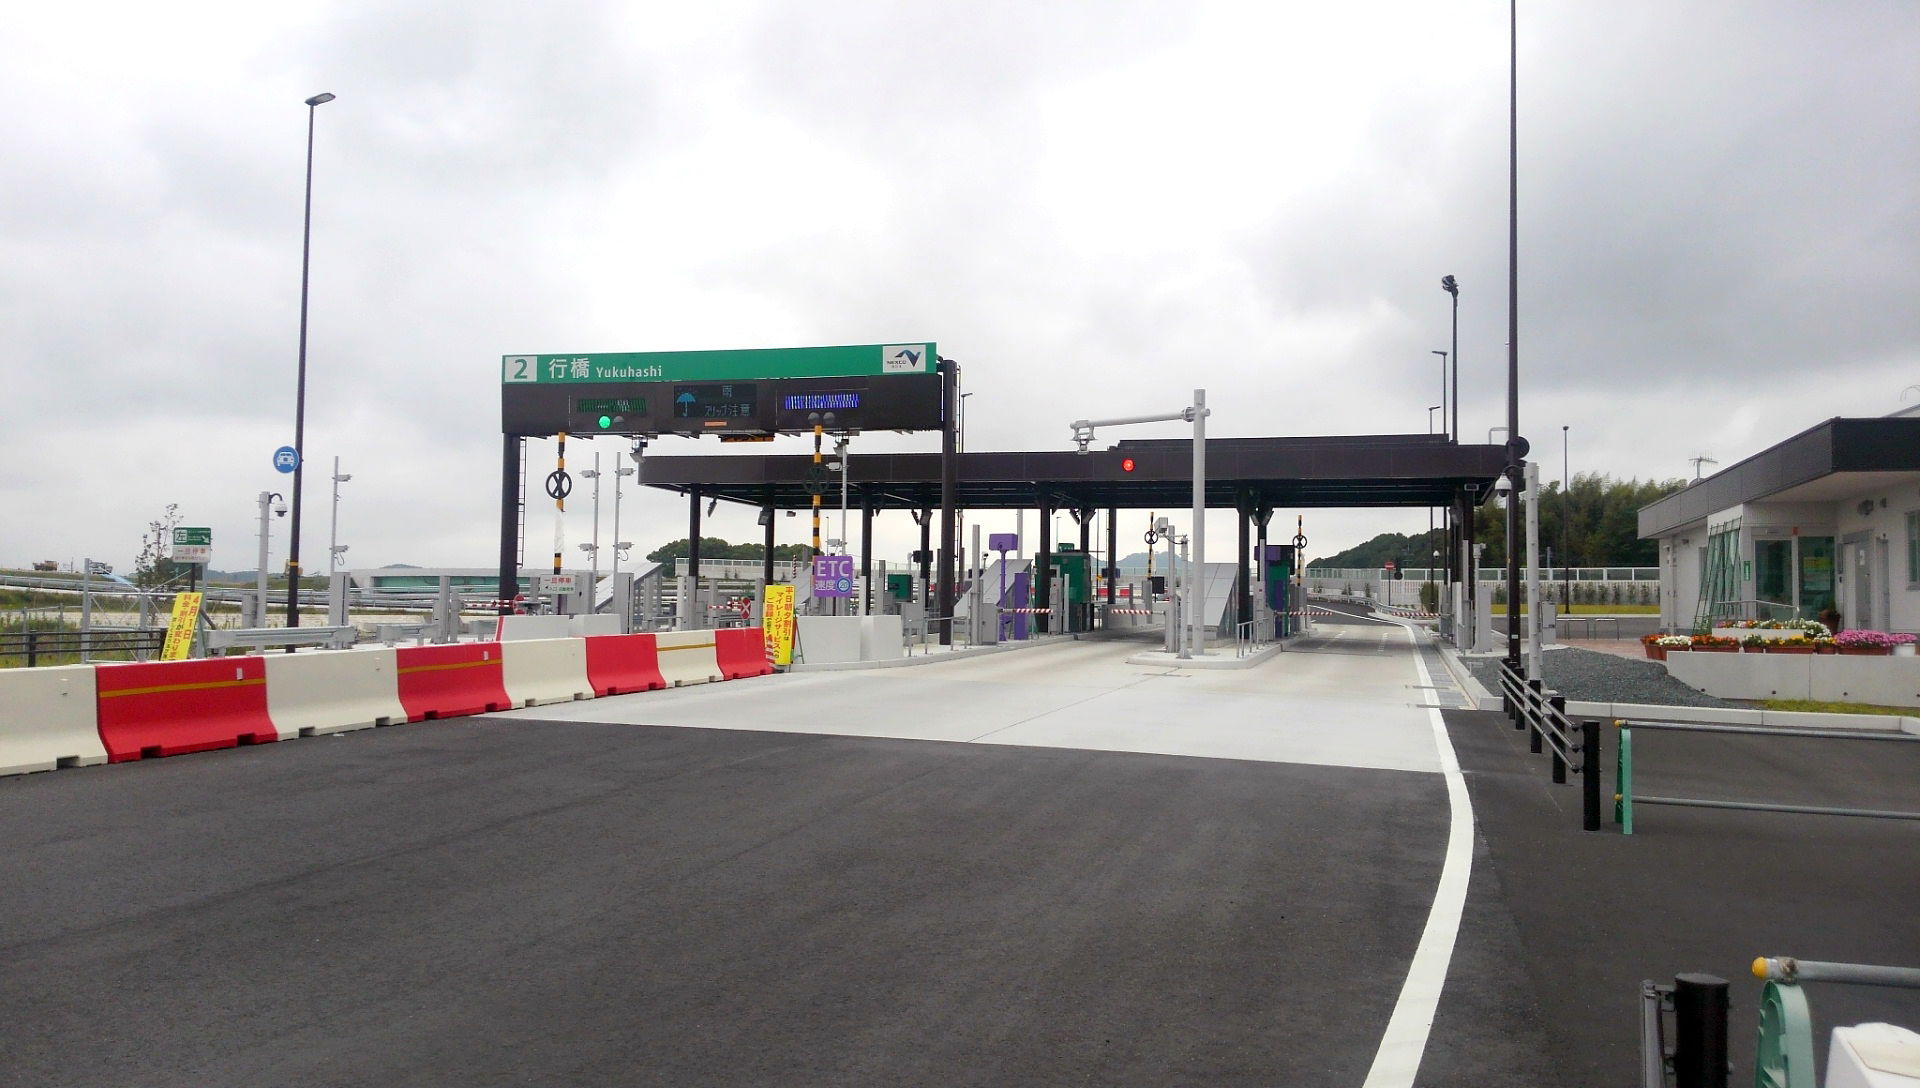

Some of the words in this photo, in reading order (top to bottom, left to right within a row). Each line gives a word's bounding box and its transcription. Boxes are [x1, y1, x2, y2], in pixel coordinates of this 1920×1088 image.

[513, 358, 528, 379] 2
[548, 357, 591, 379] 行橋
[596, 365, 662, 378] Yukuhashi
[175, 530, 186, 542] 左
[817, 560, 850, 577] ETC
[815, 580, 836, 591] 速度
[168, 594, 191, 660] 料金・割引が変わりま
[183, 595, 200, 640] 4月1日
